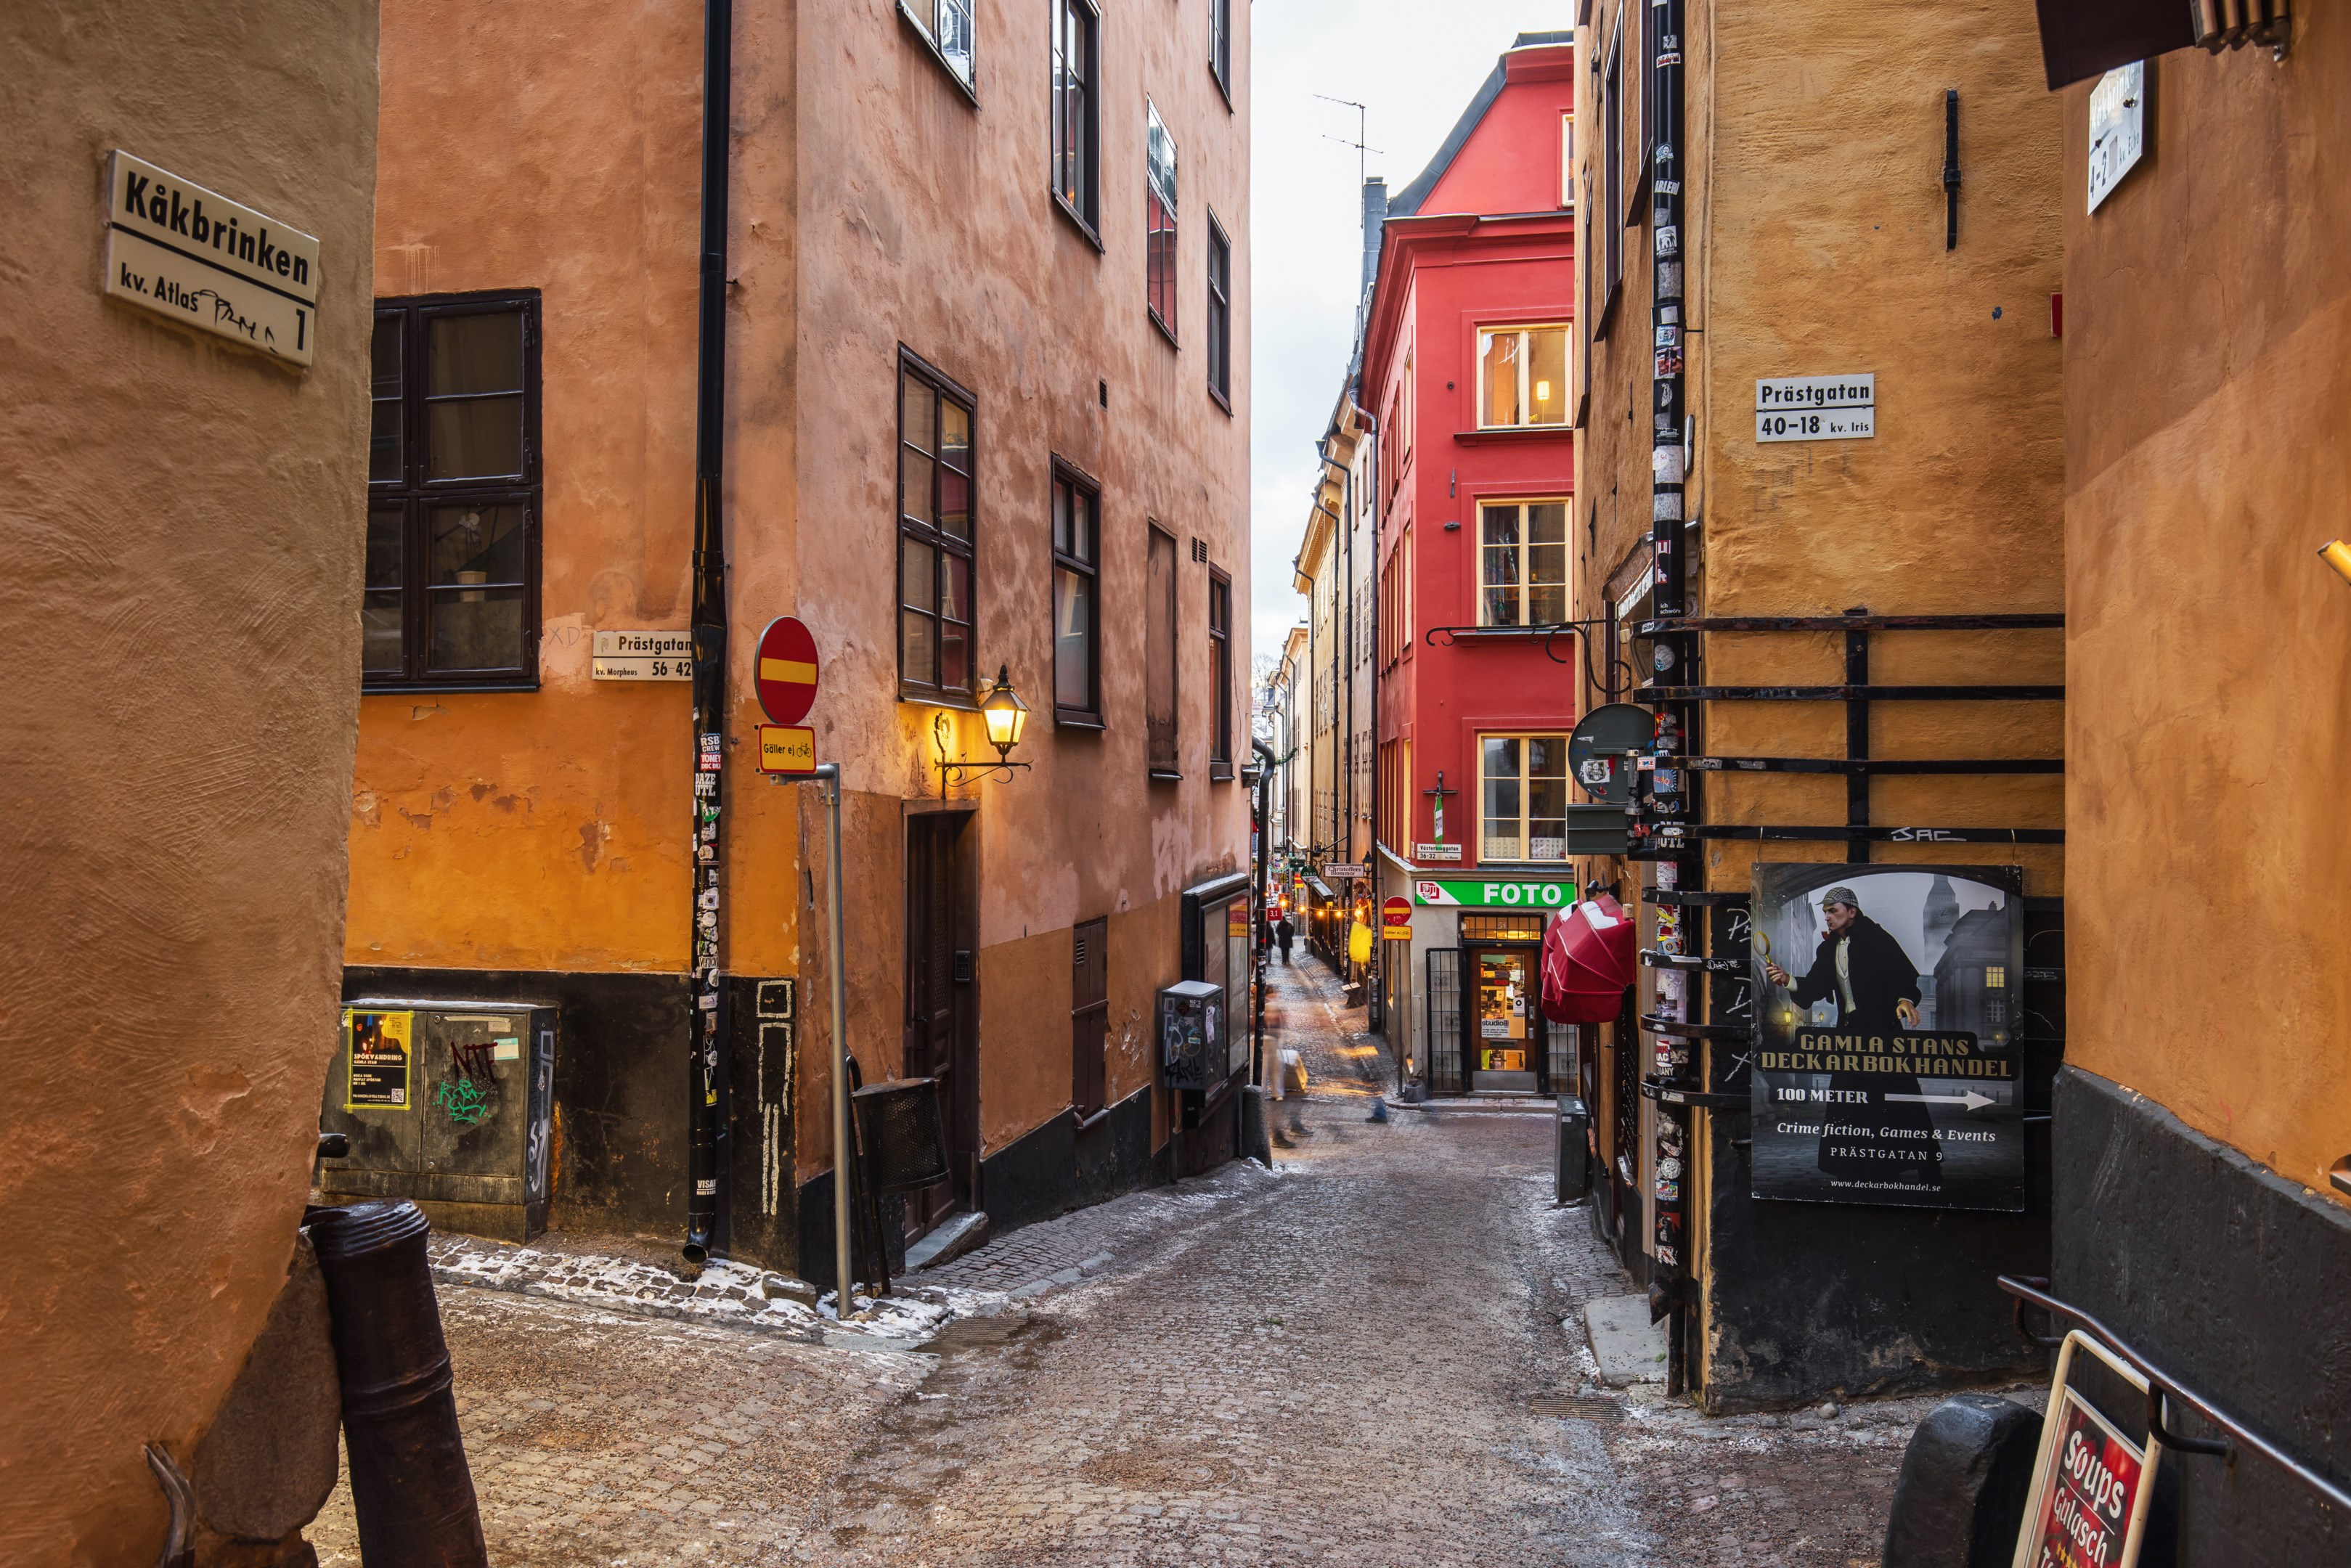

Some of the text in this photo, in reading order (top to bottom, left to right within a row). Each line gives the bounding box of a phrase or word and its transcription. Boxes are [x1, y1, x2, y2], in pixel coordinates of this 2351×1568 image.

[2128, 131, 2140, 155] Echo
[125, 170, 309, 286] Kåkbrinken
[121, 262, 148, 294] kv.
[154, 276, 198, 312] Atlas
[296, 308, 306, 351] 1
[1761, 384, 1869, 406] Prästgatan
[1761, 415, 1869, 436] 40-18 kv. Iris
[618, 636, 691, 656] Prästgatan
[595, 666, 606, 676] kv.
[607, 667, 638, 677] Morpheus
[700, 735, 720, 747] RSB
[763, 743, 795, 757] Gäller ej
[695, 773, 716, 785] DAZE
[1483, 884, 1561, 905] FOTO
[1800, 1034, 1969, 1055] GAMLA STANS
[354, 1053, 403, 1061] SPÖKVANDRING
[1761, 1052, 2012, 1077] DECKARBOKHANDEL
[1777, 1088, 1868, 1104] 100 METER
[1777, 1122, 1996, 1143] Crime fiction, Games & Events
[1830, 1146, 1943, 1161] PRÄSTGATAN 9
[1830, 1180, 1941, 1193] www.deckarbokhandel.se
[2064, 1430, 2124, 1519] Soups
[2053, 1487, 2108, 1564] Gulasch
